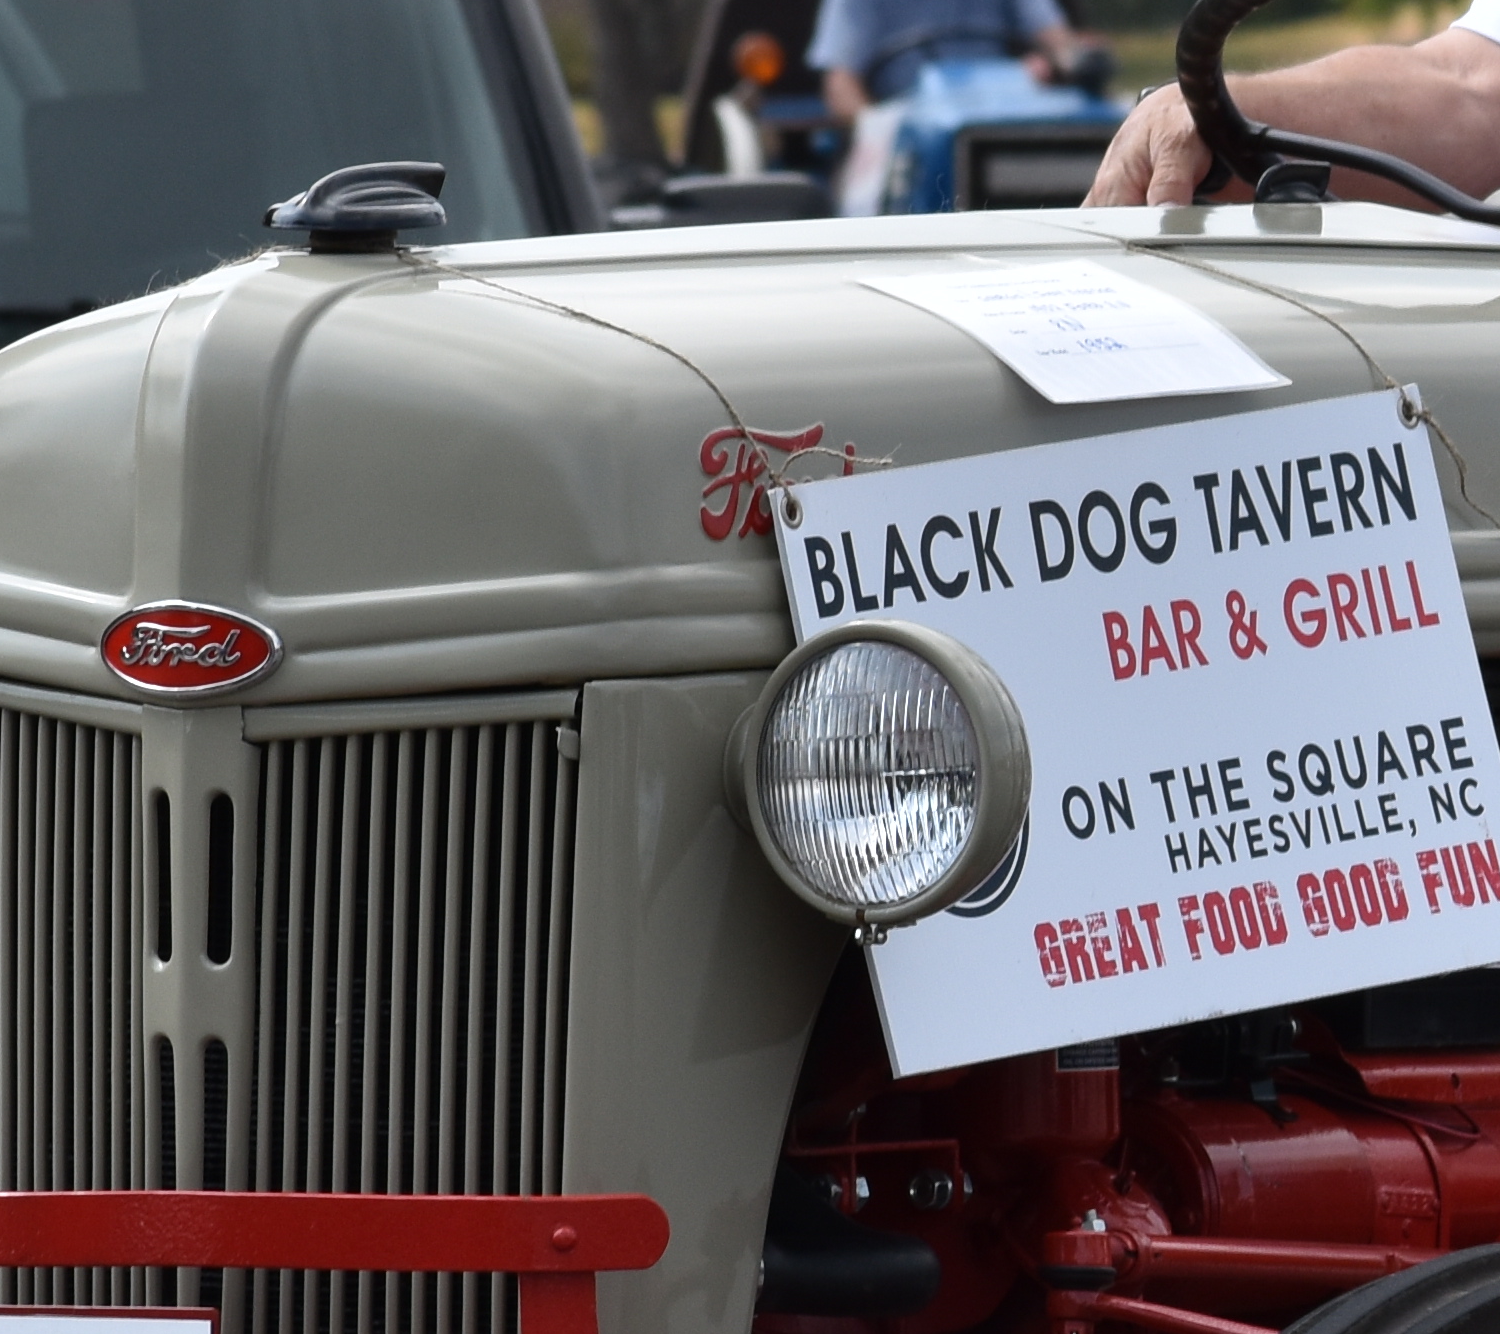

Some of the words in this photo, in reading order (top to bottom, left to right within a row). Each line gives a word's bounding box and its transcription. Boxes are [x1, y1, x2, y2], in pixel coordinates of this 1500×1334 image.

[805, 504, 1016, 618] BLACK
[1030, 481, 1180, 583] DOG
[1194, 442, 1420, 551] TAVERN
[121, 621, 241, 667] Ford
[1103, 598, 1210, 682] BAR
[1229, 589, 1267, 659] &
[1284, 561, 1441, 649] GRILL
[1061, 778, 1136, 840] ON
[1150, 756, 1250, 823] THE
[1266, 718, 1474, 799] SQUARE
[1165, 793, 1420, 873] HAYESVILLE,
[1431, 779, 1486, 823] NC
[1033, 900, 1170, 988] GREAT
[1177, 881, 1288, 959] FOOD
[1297, 859, 1410, 936] GOOD
